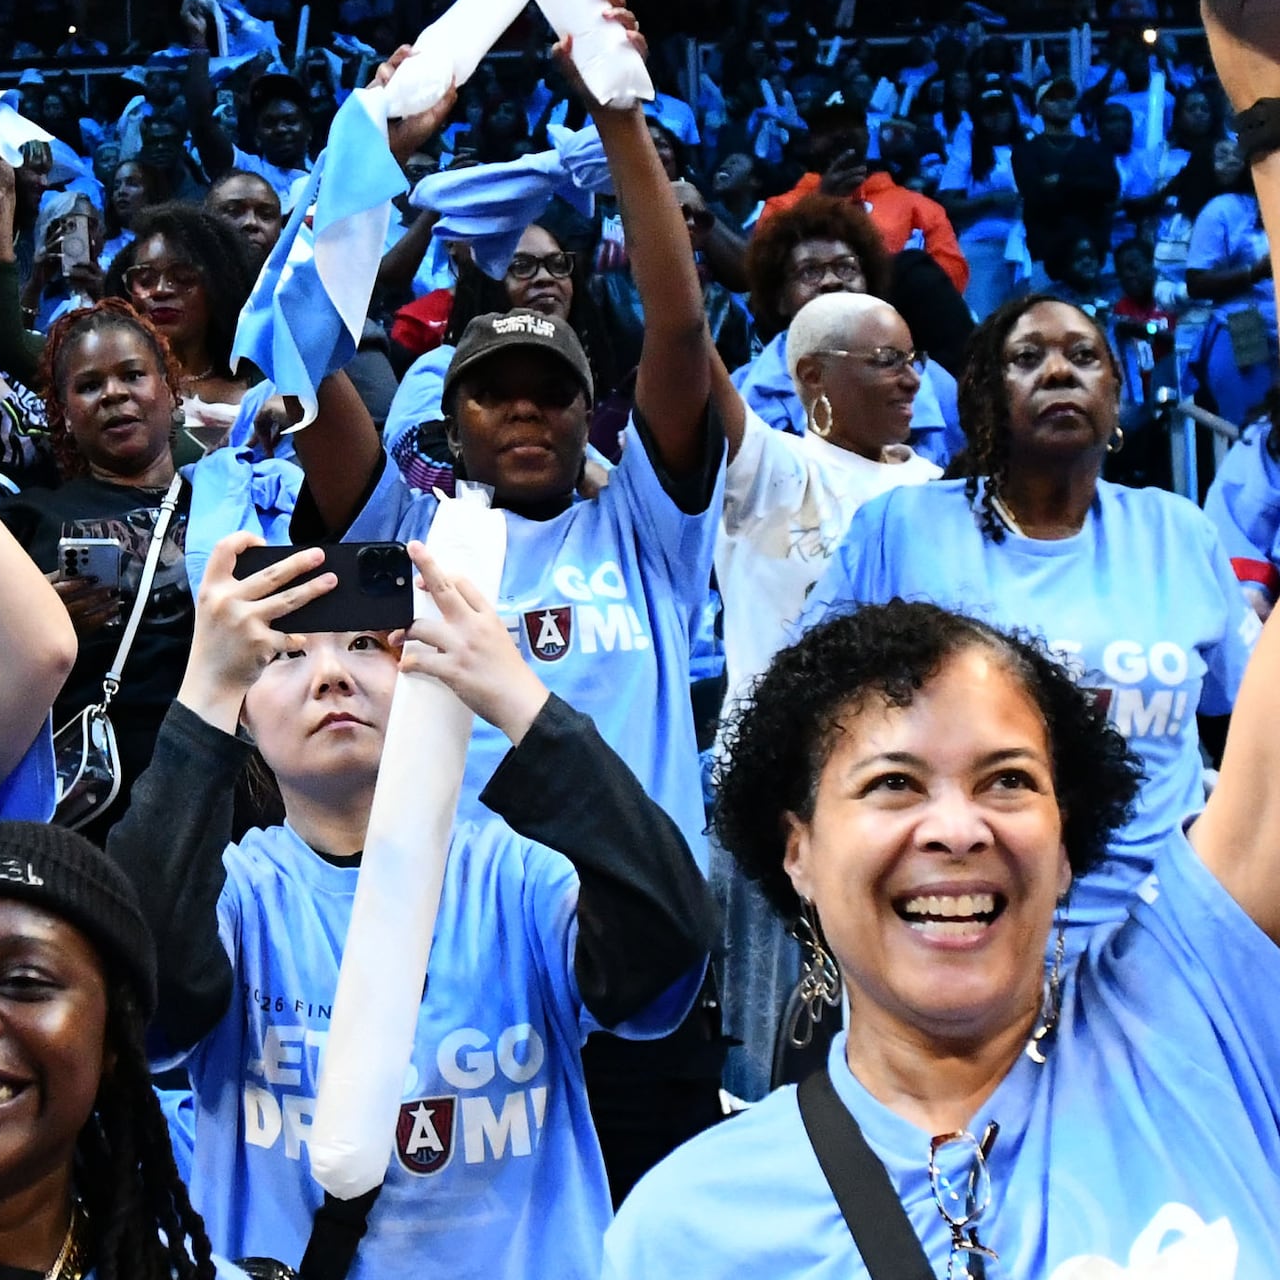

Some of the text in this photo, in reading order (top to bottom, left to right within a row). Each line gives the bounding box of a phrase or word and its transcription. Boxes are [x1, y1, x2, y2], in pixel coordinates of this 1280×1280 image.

[492, 314, 555, 333] break up
[552, 560, 628, 601] GO
[1102, 639, 1189, 686] GO
[436, 1022, 545, 1091] GO
